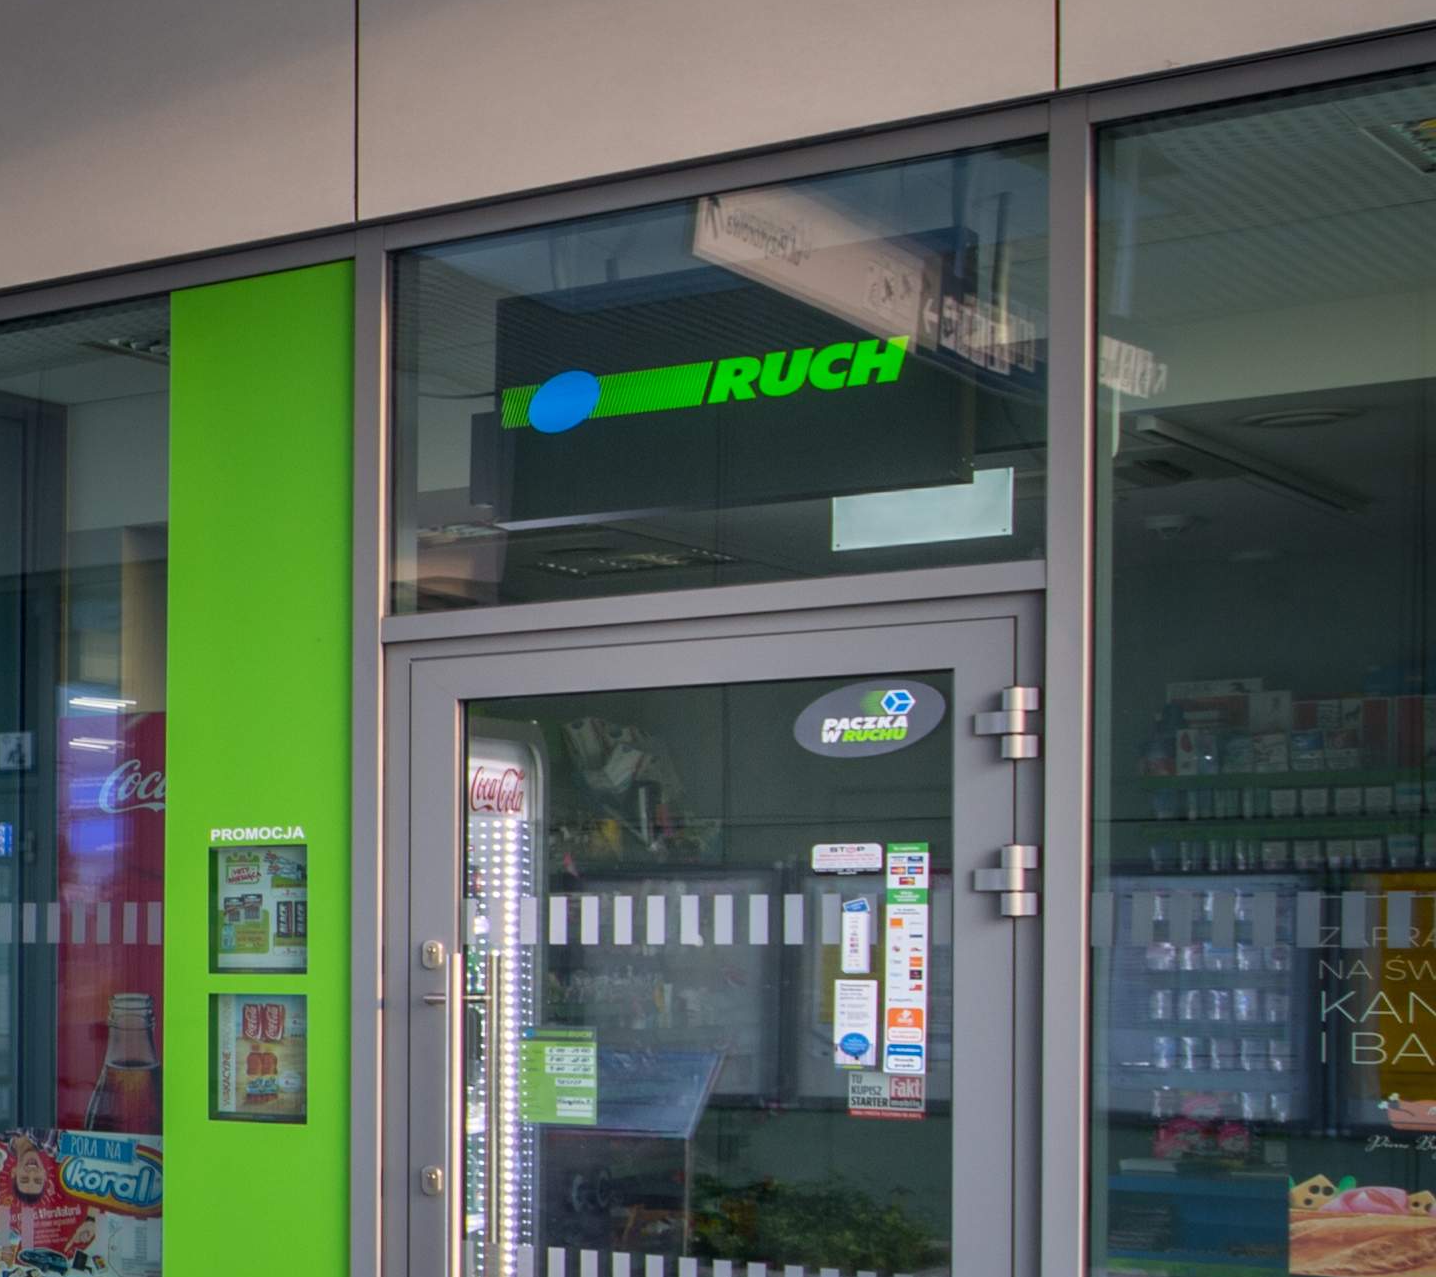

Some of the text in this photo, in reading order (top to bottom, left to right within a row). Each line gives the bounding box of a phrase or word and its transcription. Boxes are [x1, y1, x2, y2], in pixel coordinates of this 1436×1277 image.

[706, 334, 911, 405] RUCH
[822, 715, 909, 731] PACZKA
[821, 726, 908, 744] W RUCHU
[210, 825, 305, 842] PROMOCJA
[1318, 959, 1374, 980] NA
[1320, 1031, 1436, 1066] I BA
[890, 1076, 923, 1099] Fakt
[851, 1096, 888, 1108] STARTER
[69, 1135, 122, 1160] PORA NA
[70, 1161, 150, 1203] koral
